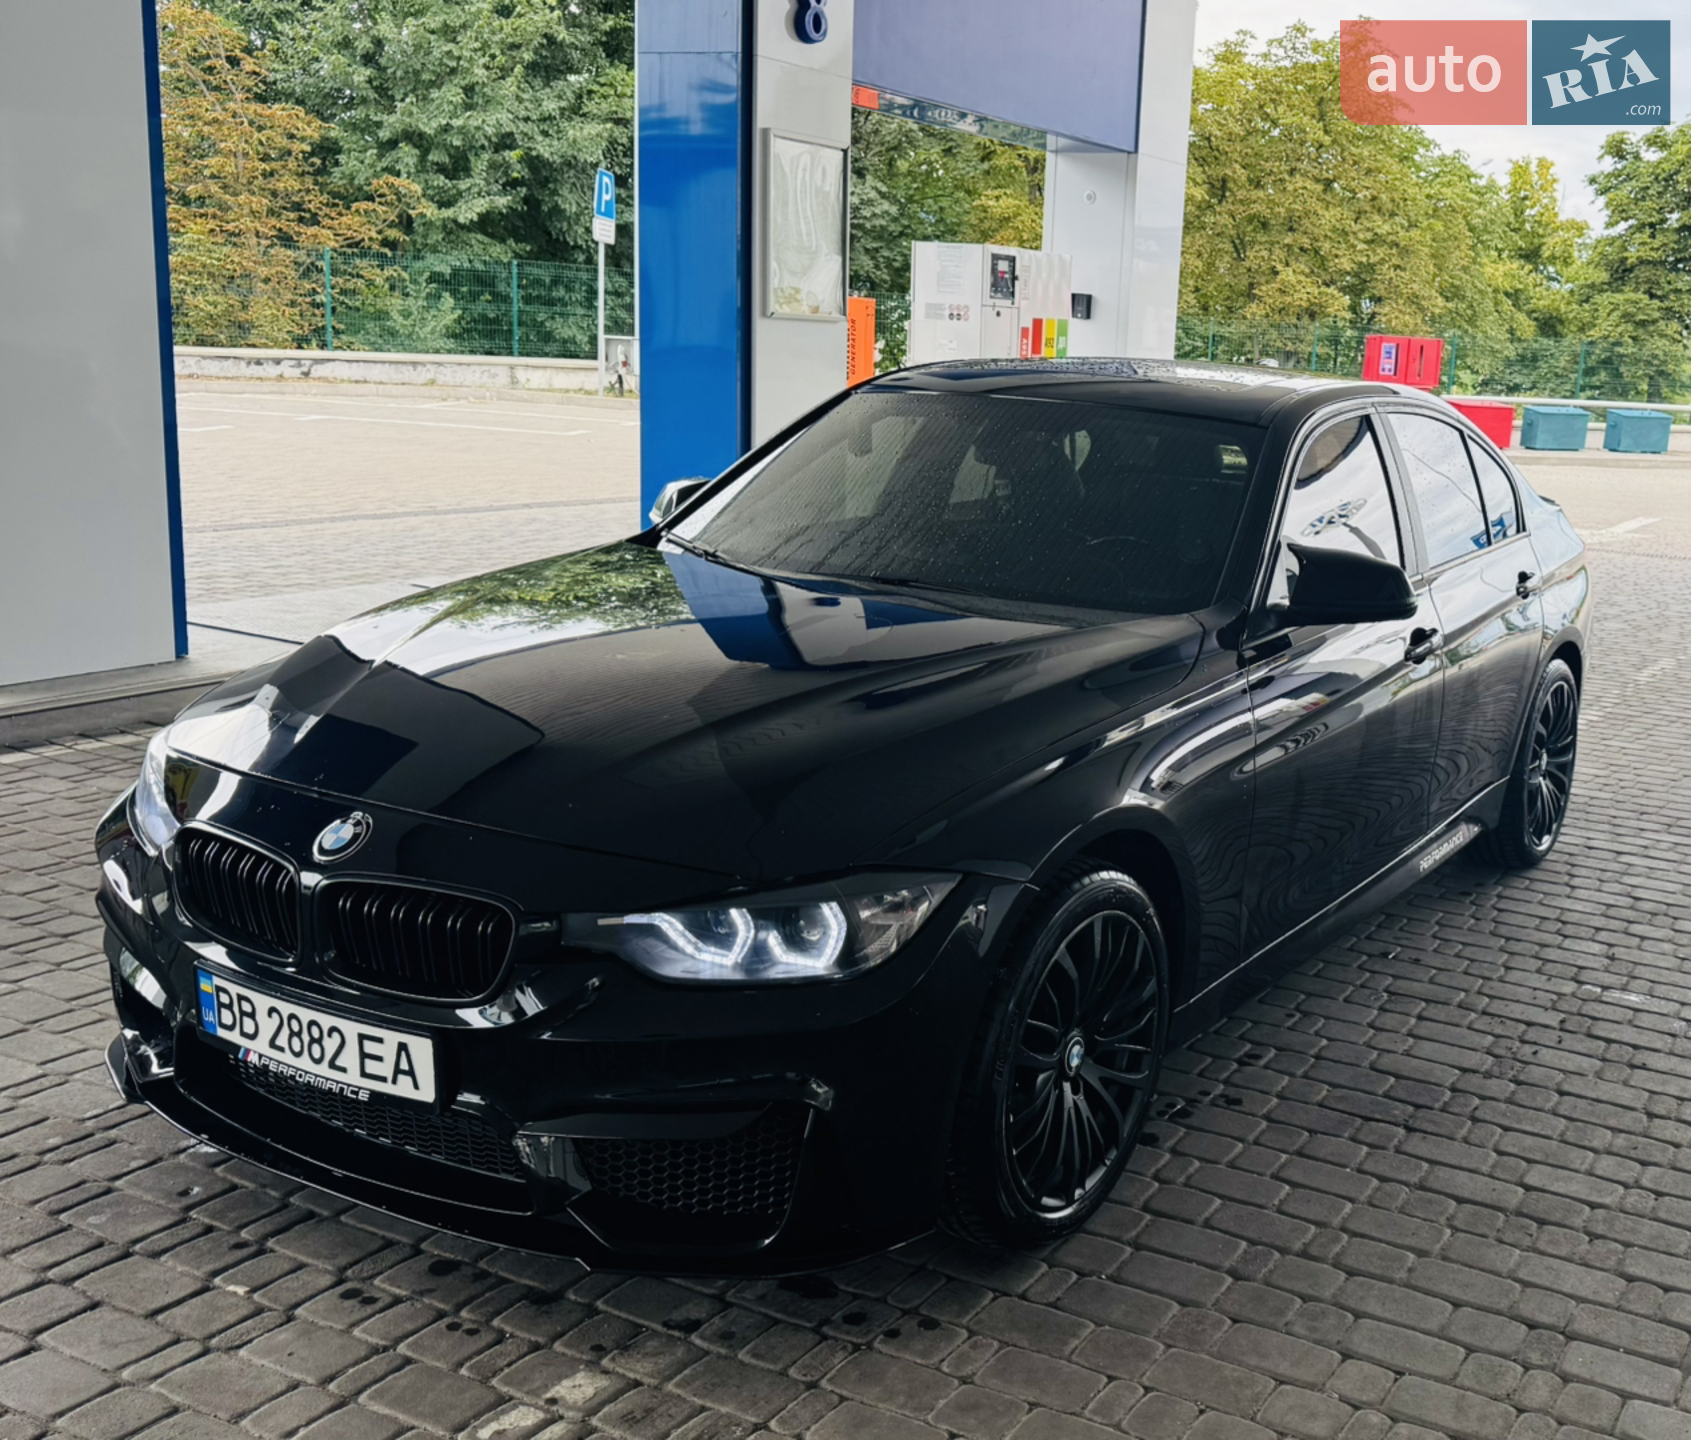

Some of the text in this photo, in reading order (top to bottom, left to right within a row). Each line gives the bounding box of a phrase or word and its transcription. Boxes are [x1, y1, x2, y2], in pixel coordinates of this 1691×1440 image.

[601, 174, 612, 213] P
[202, 1006, 215, 1024] UA
[214, 984, 420, 1091] BB 2882 EA
[260, 1057, 371, 1101] PERFORMANCE
